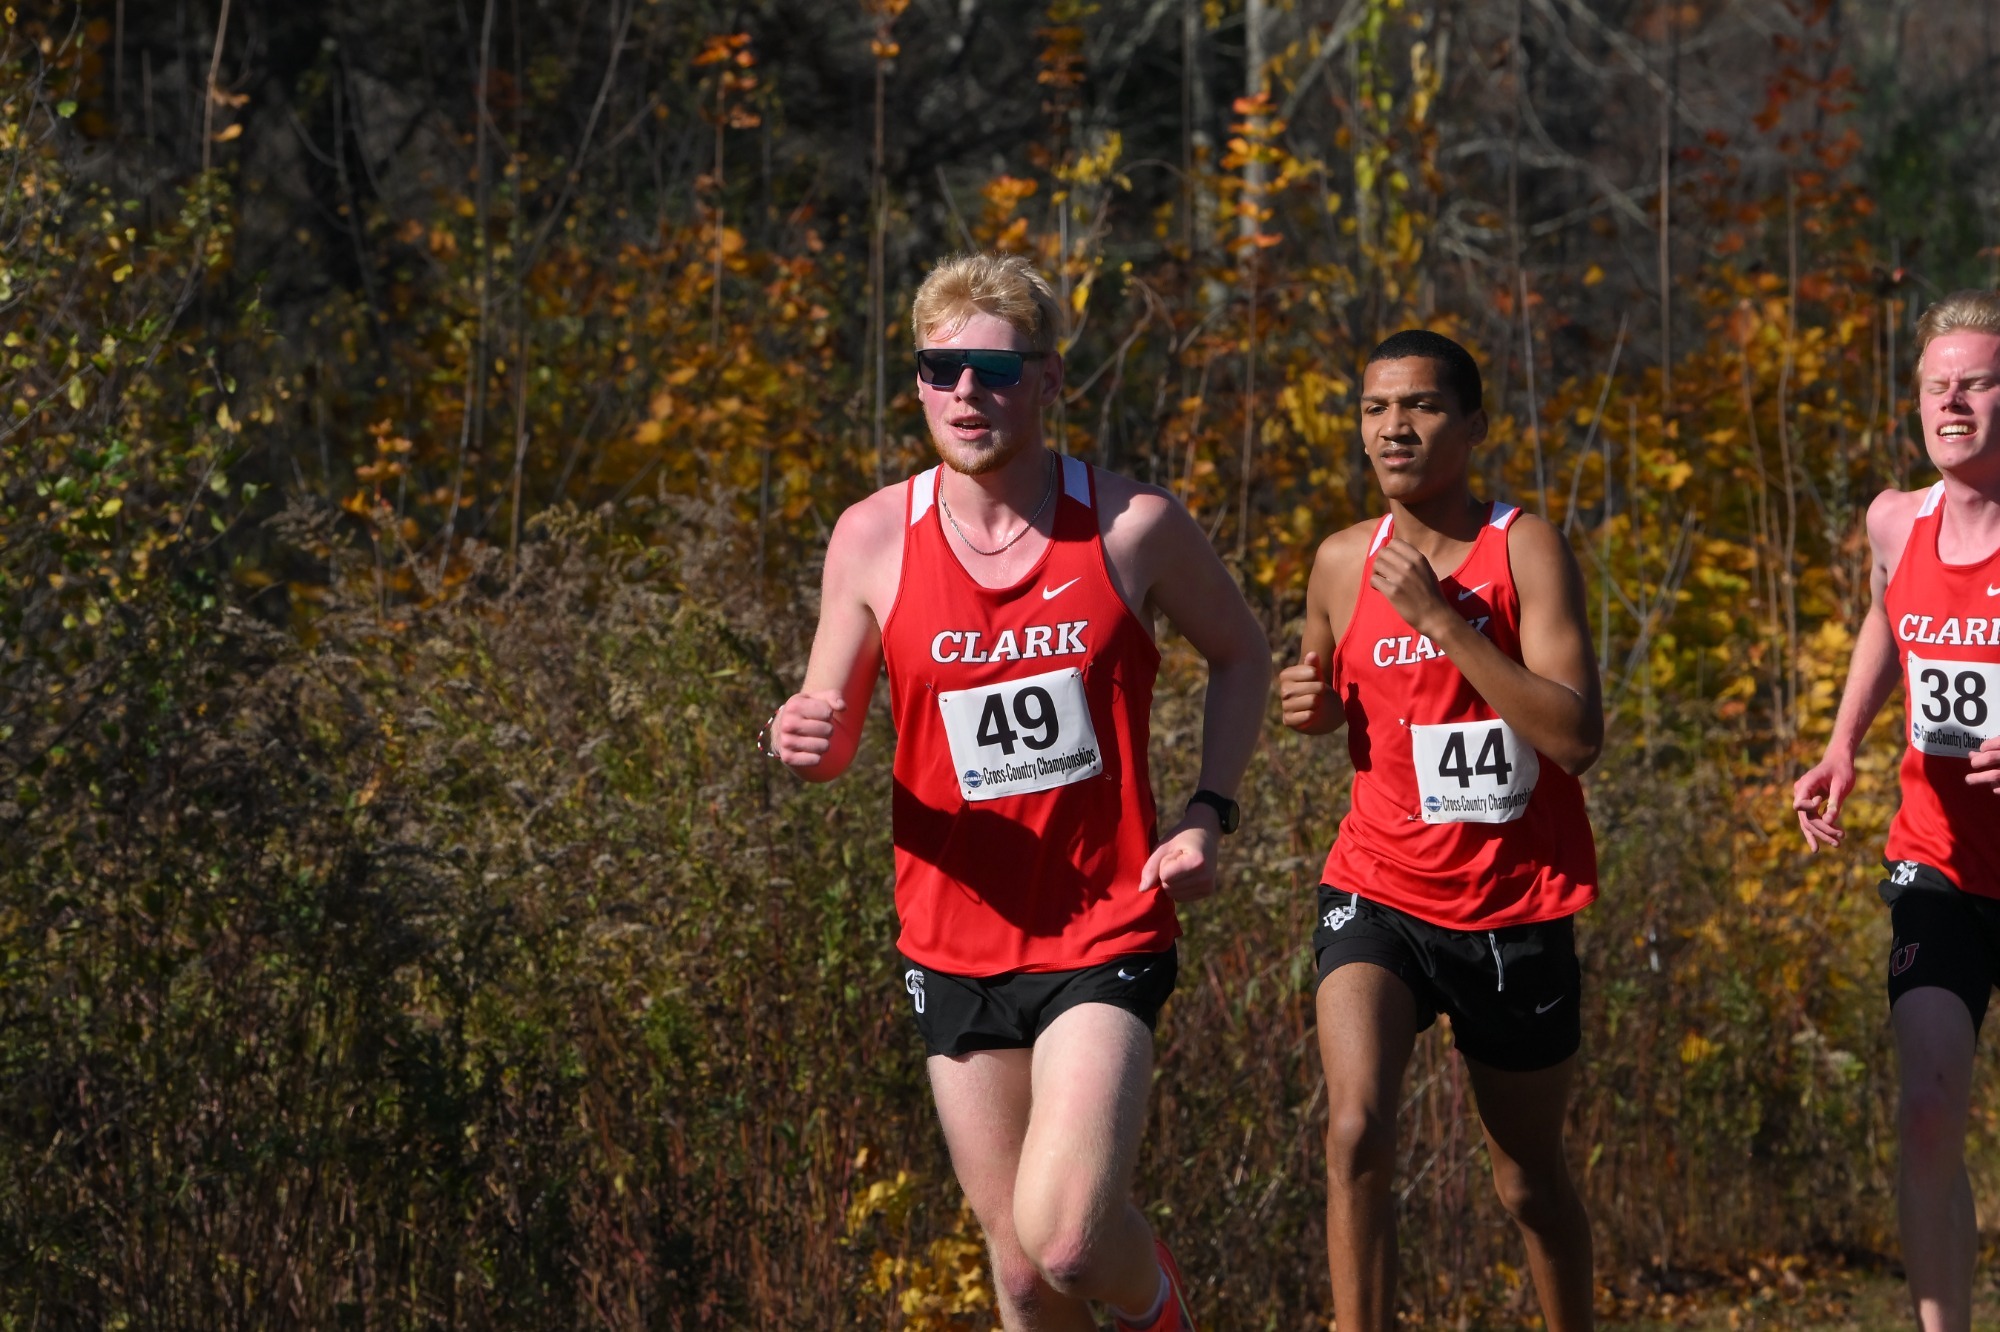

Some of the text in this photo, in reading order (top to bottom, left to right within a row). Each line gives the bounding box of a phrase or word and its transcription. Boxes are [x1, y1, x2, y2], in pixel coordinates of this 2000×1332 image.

[930, 620, 1089, 664] CLARK
[1373, 616, 1490, 668] CLA
[976, 686, 1060, 756] 49
[1920, 668, 1988, 728] 38
[1438, 727, 1513, 789] 44
[1921, 726, 1963, 749] Cross-Country
[982, 761, 1037, 786] Cross-Country
[1036, 747, 1097, 775] Championships
[1442, 795, 1487, 813] Cross-Country
